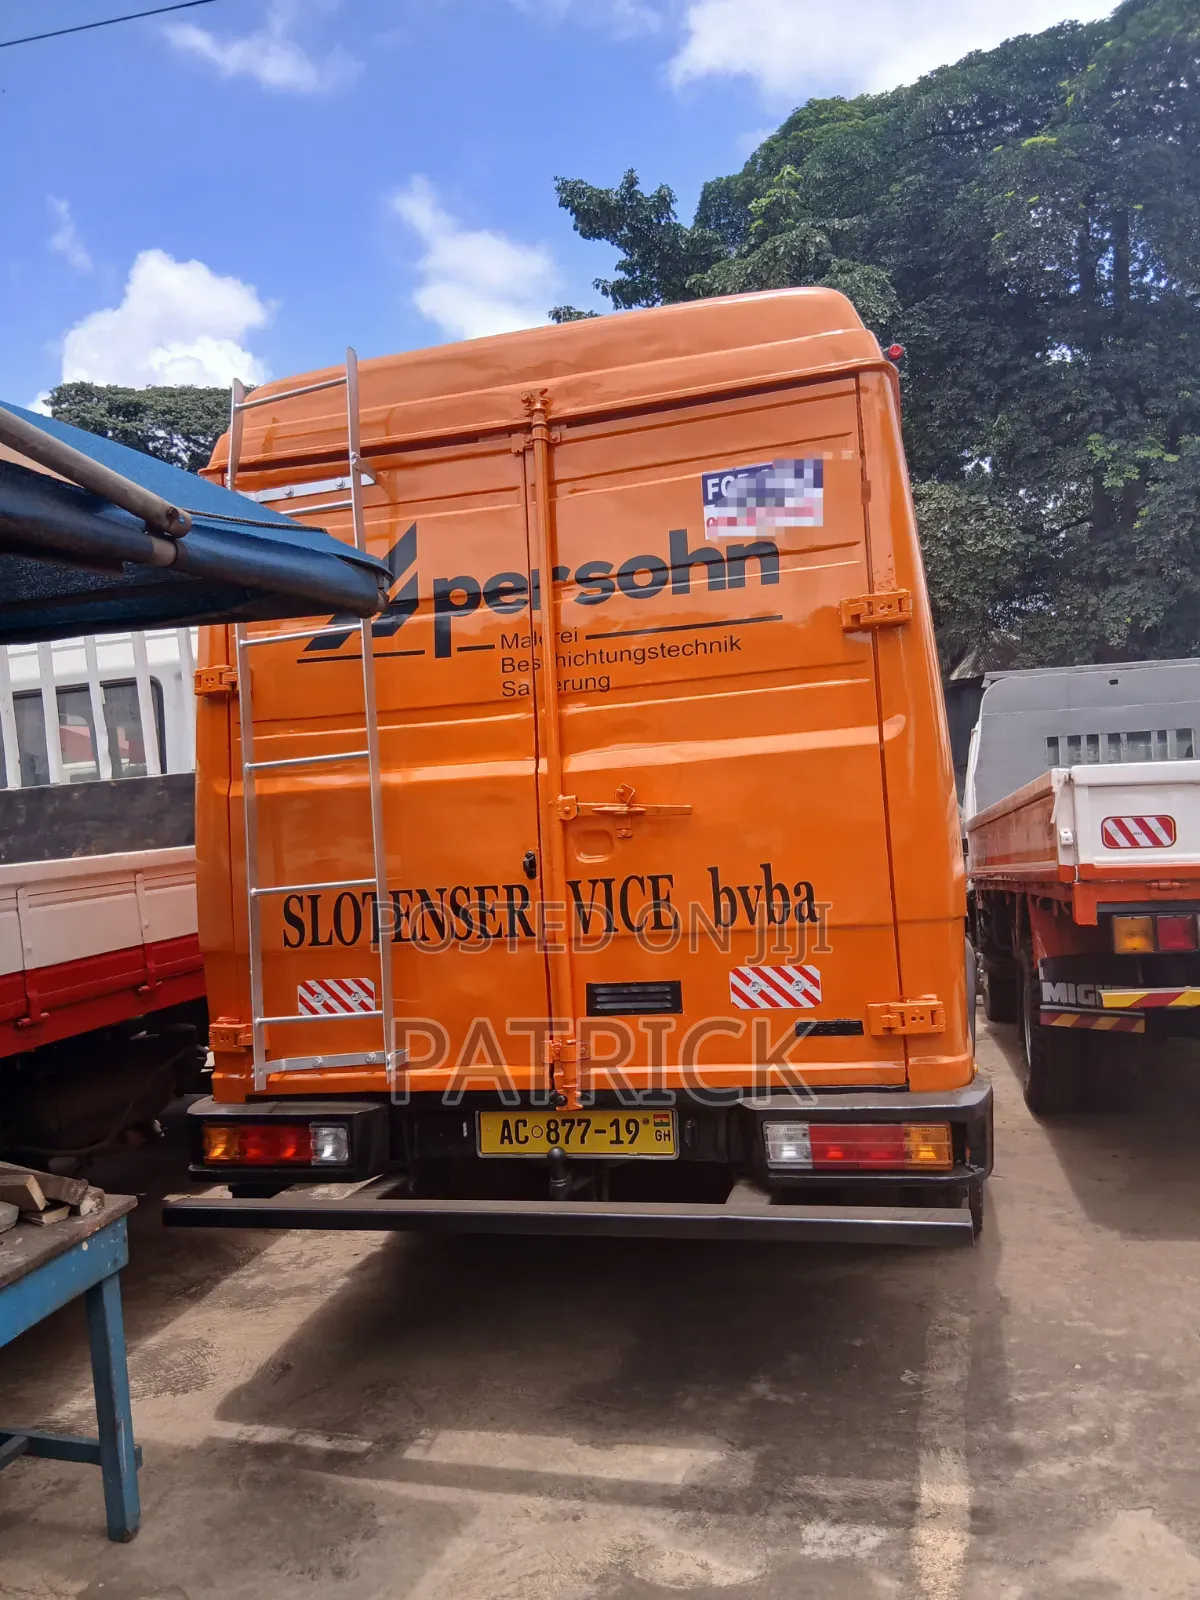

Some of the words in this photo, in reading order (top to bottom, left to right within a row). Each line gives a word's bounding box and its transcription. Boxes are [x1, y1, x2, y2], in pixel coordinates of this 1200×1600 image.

[501, 635, 742, 674] Beshichtungstechnik
[567, 874, 679, 934] VICE
[707, 863, 820, 928] bvba
[655, 1129, 671, 1142] GH
